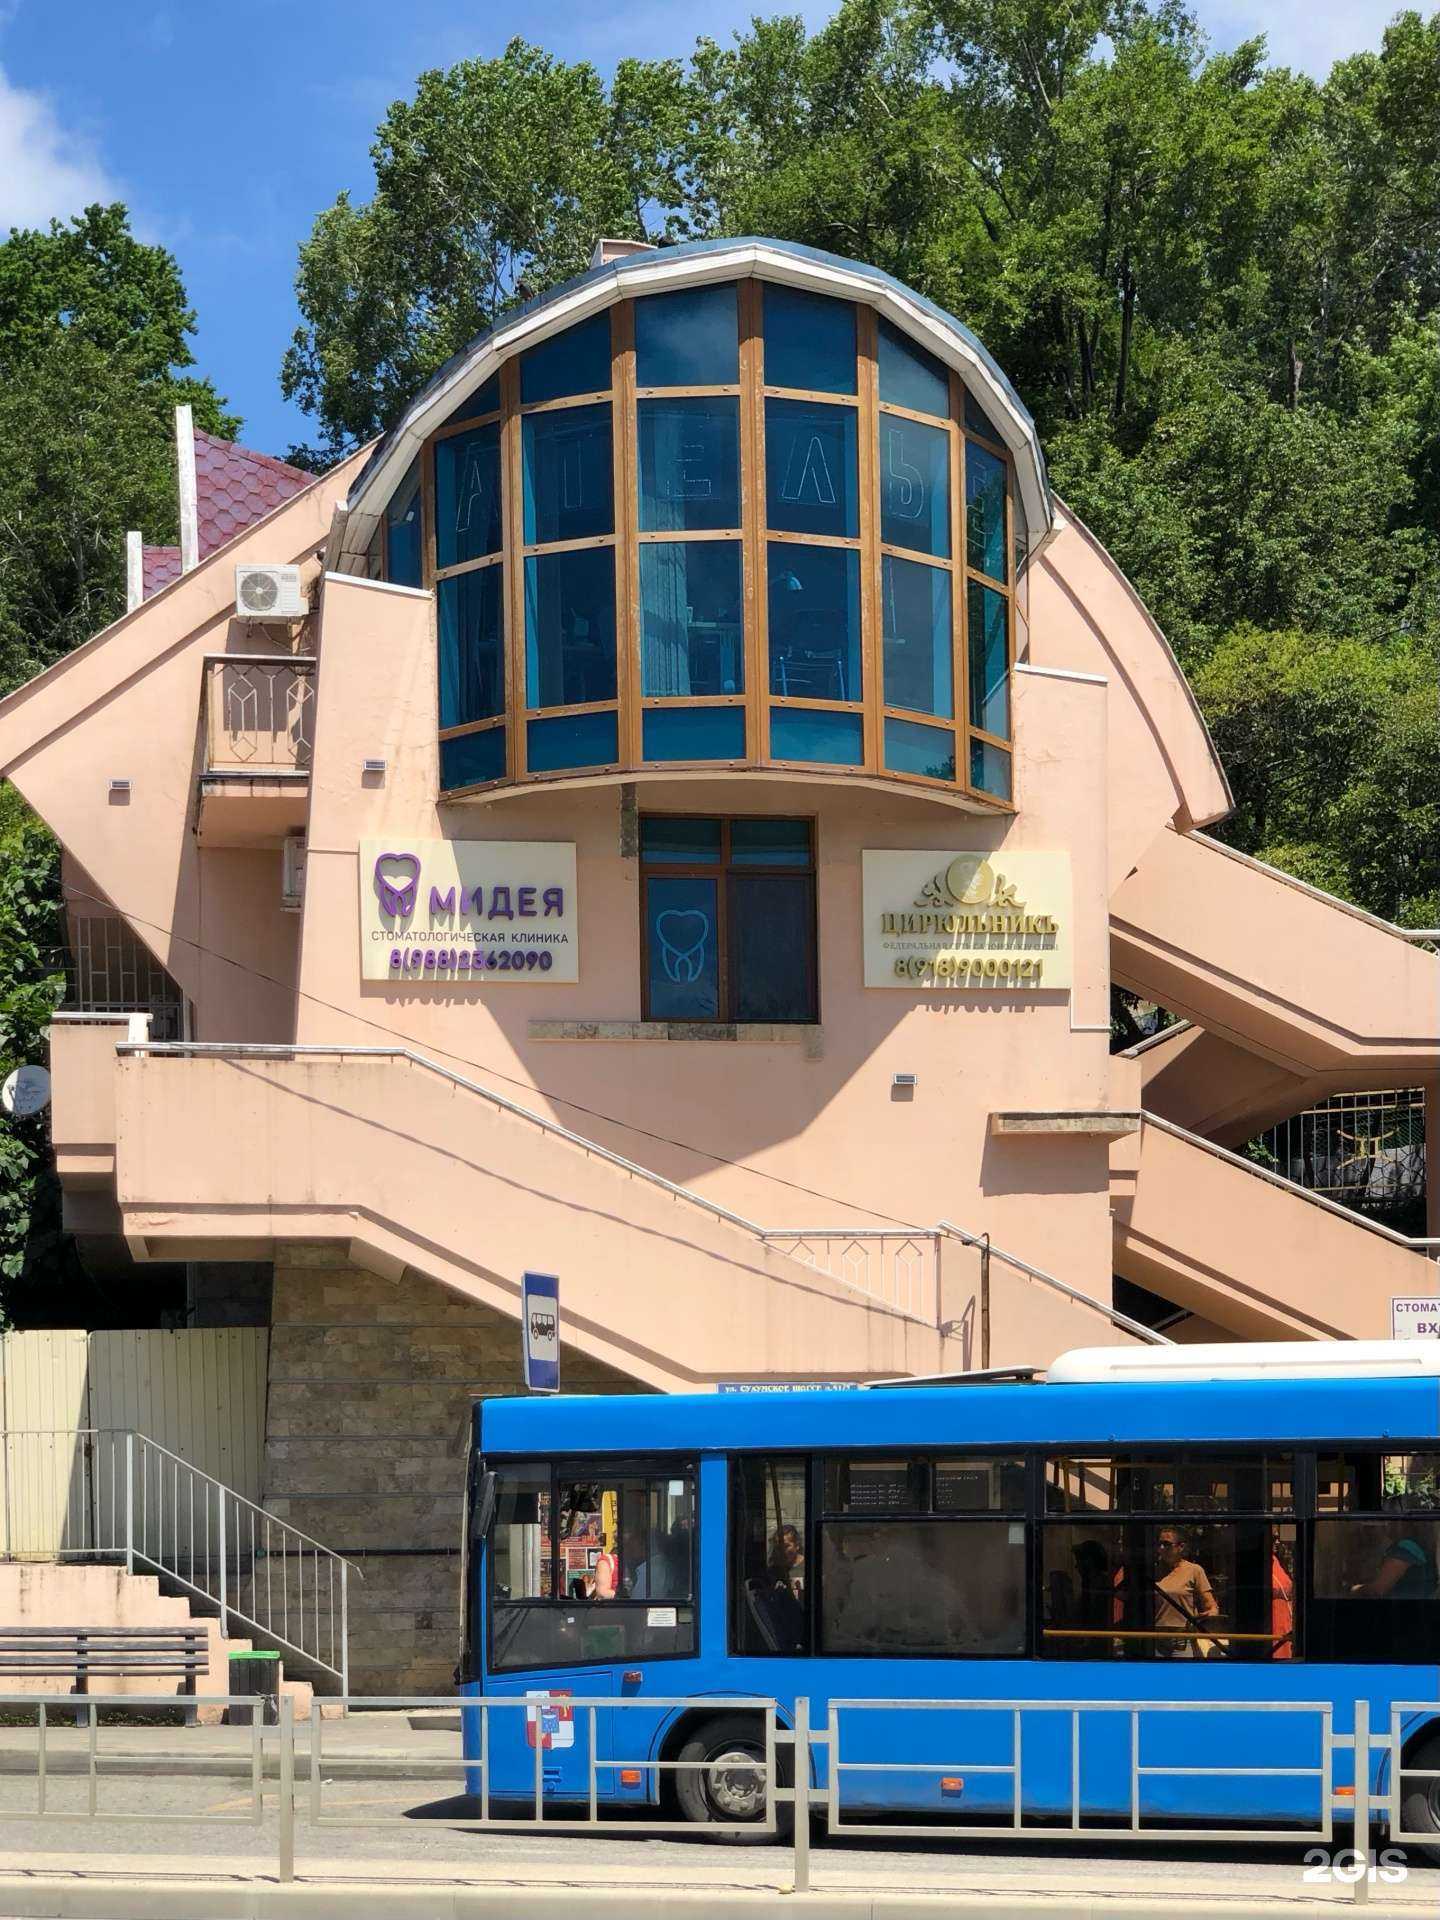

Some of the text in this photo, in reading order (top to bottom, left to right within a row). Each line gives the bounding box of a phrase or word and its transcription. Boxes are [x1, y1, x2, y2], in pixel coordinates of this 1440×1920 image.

[429, 886, 564, 920] МИДЕЯ
[881, 912, 1059, 936] ЦИРЮЛЬНИКЪ
[371, 930, 569, 944] СТОМАТОЛОГИЧЕСКАЯ КЛИНИКА
[894, 955, 1043, 979] 8(918)9000121
[1395, 1303, 1440, 1312] СТОМА
[1417, 1322, 1440, 1334] ВХ
